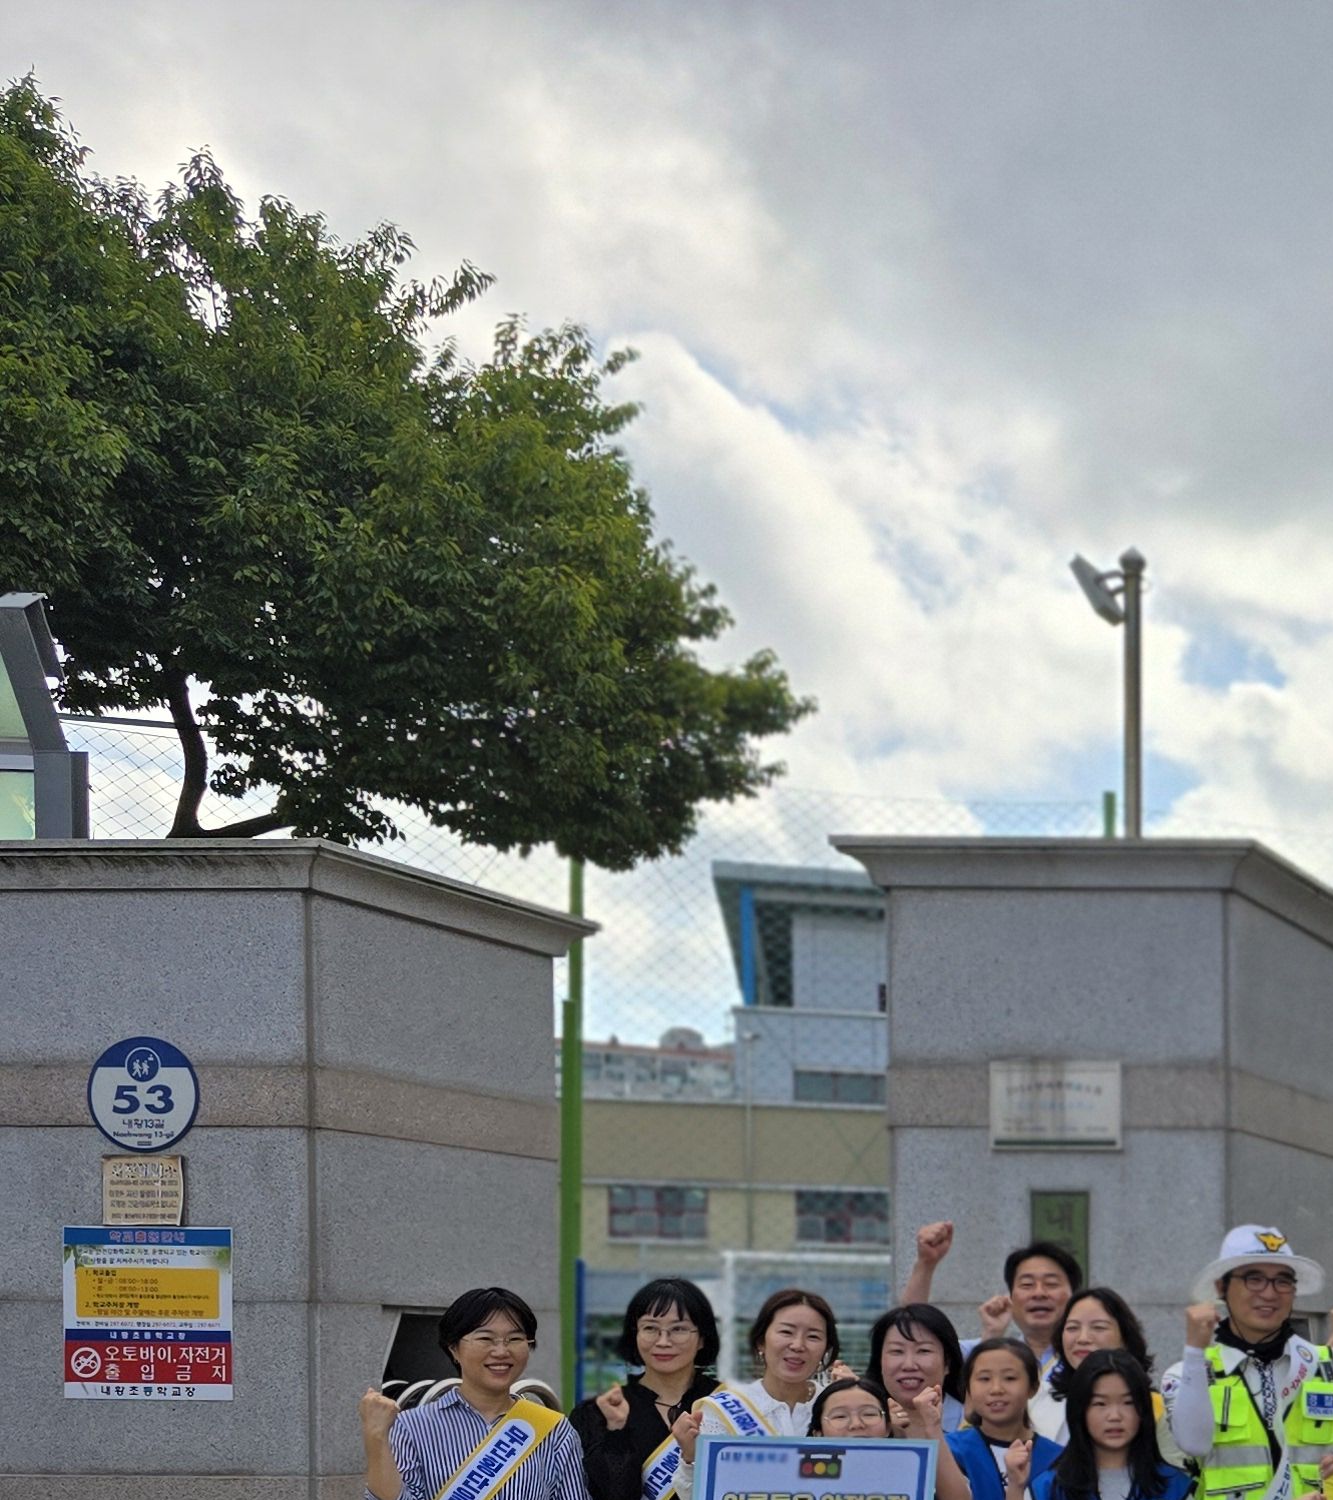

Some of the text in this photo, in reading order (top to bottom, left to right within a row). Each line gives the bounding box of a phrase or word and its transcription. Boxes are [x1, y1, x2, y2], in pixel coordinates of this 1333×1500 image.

[112, 1085, 174, 1114] 53
[122, 1119, 164, 1129] 내황13길
[101, 1386, 196, 1397] 내황초등학교장
